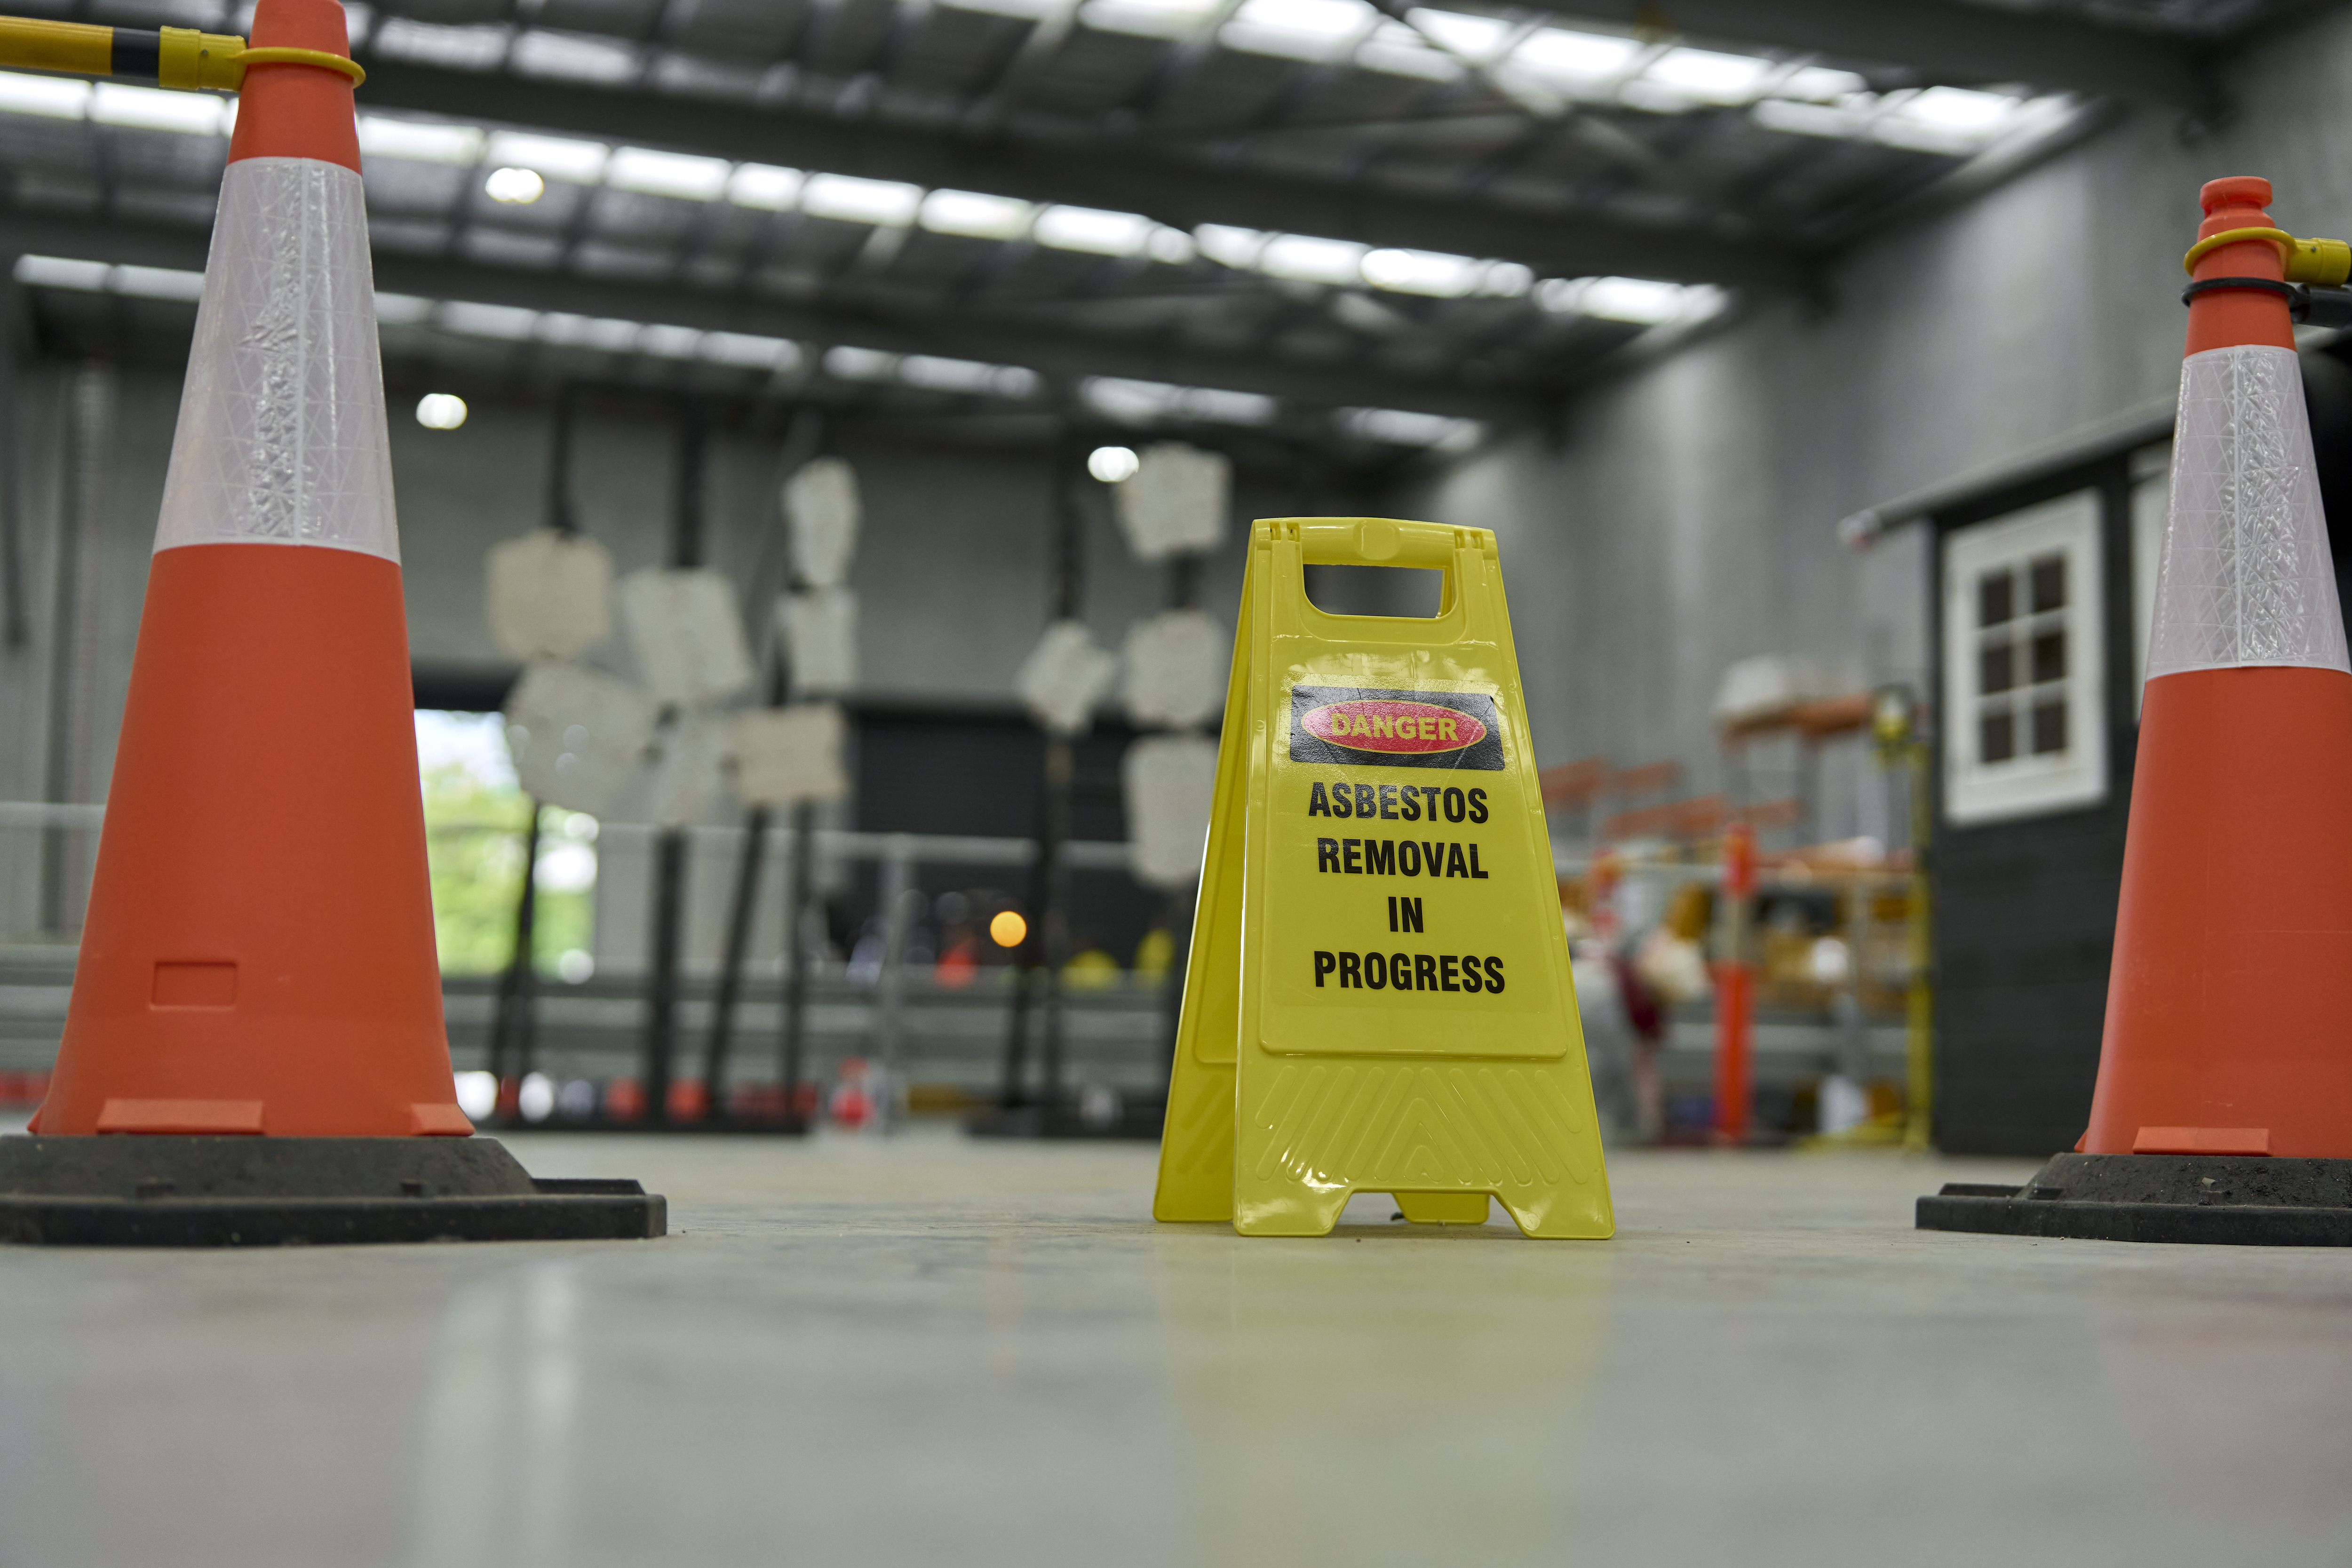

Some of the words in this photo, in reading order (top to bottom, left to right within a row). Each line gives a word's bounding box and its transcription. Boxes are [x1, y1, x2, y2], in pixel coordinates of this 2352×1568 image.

[1331, 713, 1459, 741] DANGER
[1308, 782, 1488, 823] ASBESTOS
[1317, 837, 1489, 879] REMOVAL
[1388, 896, 1424, 933] IN
[1314, 950, 1505, 994] PROGRESS
